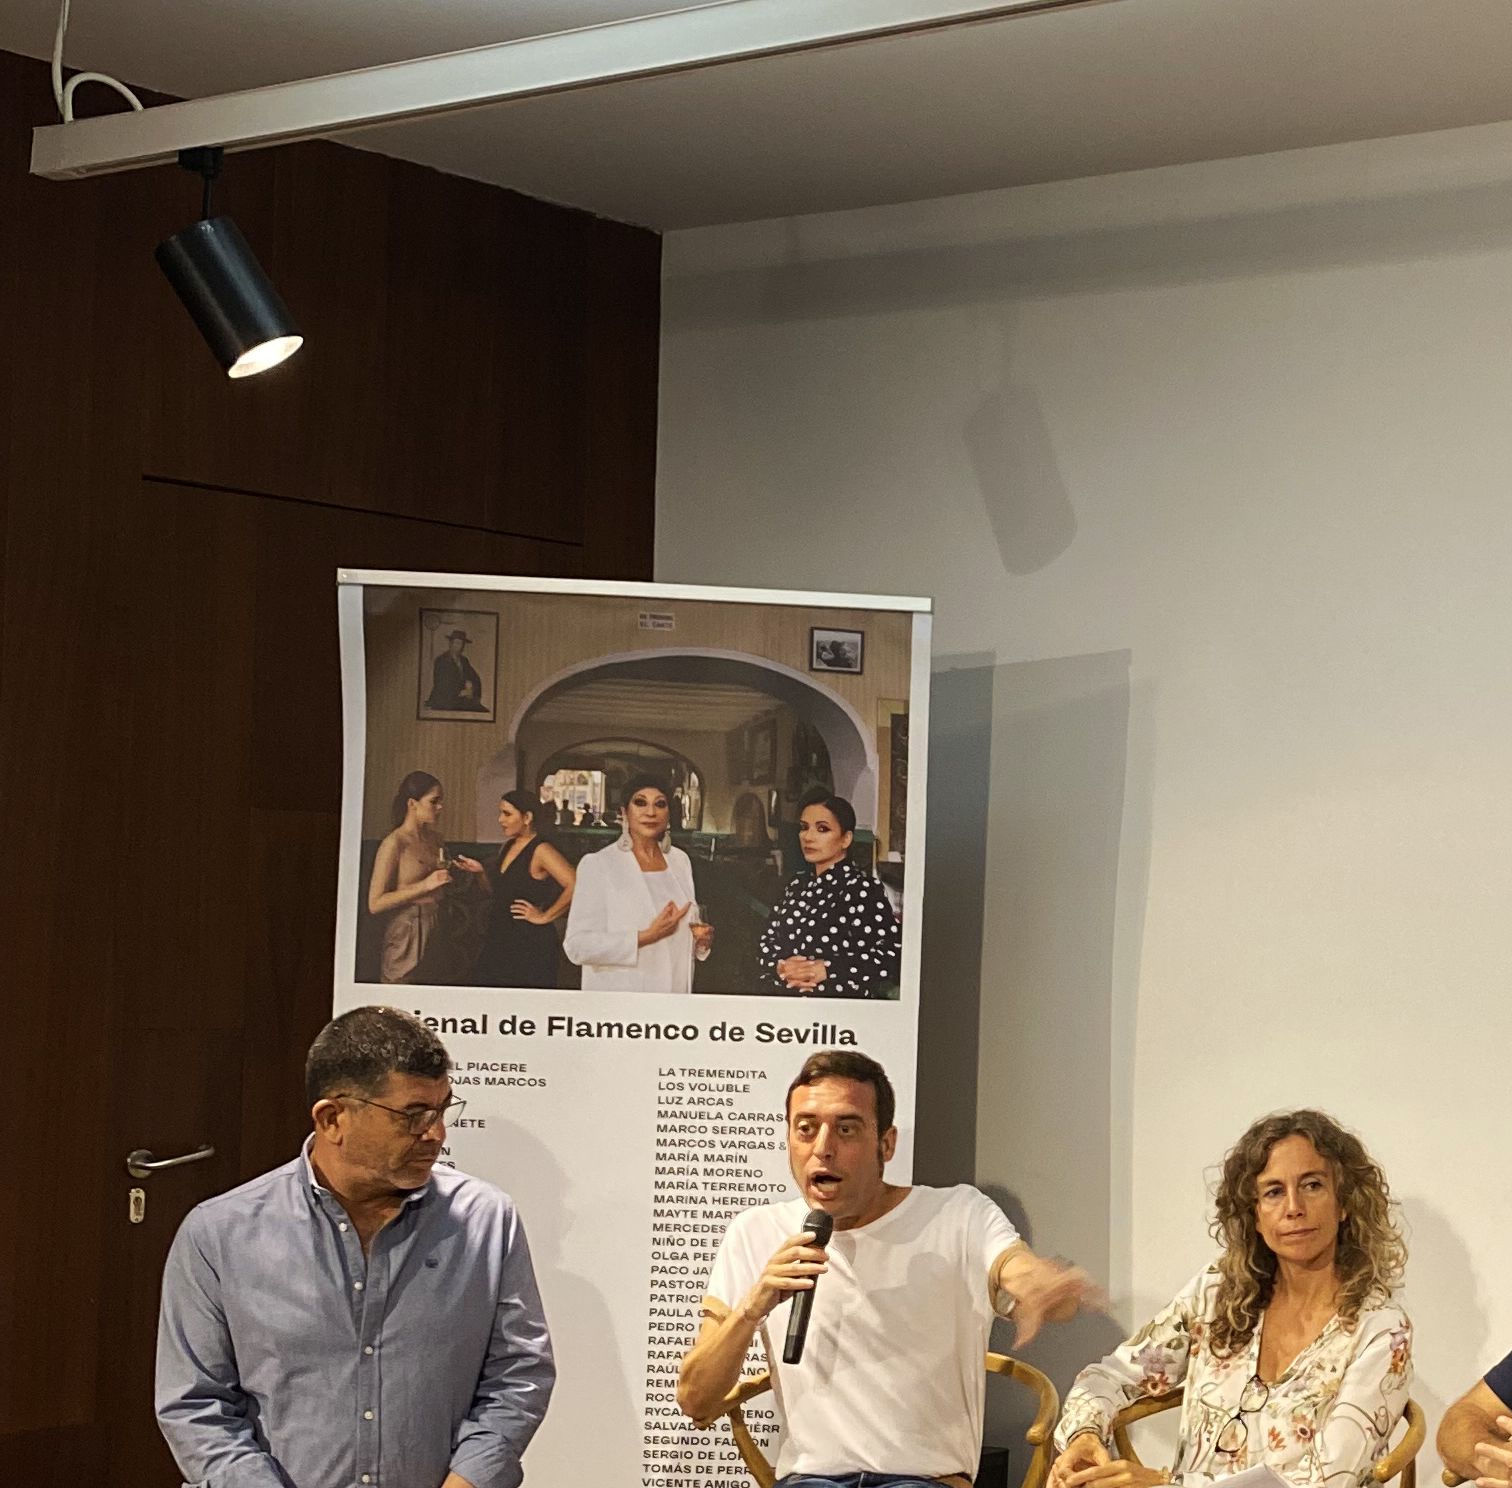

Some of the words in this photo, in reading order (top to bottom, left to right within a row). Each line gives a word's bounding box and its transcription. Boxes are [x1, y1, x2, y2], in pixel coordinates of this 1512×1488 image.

[414, 1010, 488, 1035] enal
[499, 1015, 536, 1036] de
[547, 1016, 699, 1042] Flamenco
[709, 1021, 745, 1043] de
[755, 1022, 858, 1046] Sevilla
[467, 1062, 527, 1072] PIACERE
[658, 1068, 676, 1077] LA
[680, 1068, 767, 1080] TREMENDITA
[449, 1076, 481, 1086] JAS
[484, 1077, 547, 1087] MARCOS
[658, 1081, 685, 1091] LOS
[688, 1082, 751, 1093] VOLUBLE
[657, 1096, 683, 1106] LUZ
[687, 1097, 734, 1107] ARCAS
[657, 1110, 724, 1121] MANUELA
[728, 1112, 787, 1122] CARRAS
[656, 1124, 708, 1134] MARCO
[712, 1126, 775, 1136] SERRATO
[656, 1138, 716, 1149] MARCOS
[720, 1140, 776, 1151] VARGAS
[778, 1141, 787, 1151] &
[655, 1151, 699, 1162] MARÍA
[703, 1152, 748, 1164] MARÍN
[654, 1165, 699, 1177] MARÍA
[703, 1168, 763, 1178] MORENO
[654, 1179, 699, 1191] MARÍA
[702, 1182, 787, 1193] TERREMOTO
[653, 1194, 707, 1205] MARINA
[712, 1196, 770, 1206] HEREDIA
[653, 1209, 698, 1219] MAYTE
[702, 1210, 740, 1220] MART
[652, 1223, 727, 1234] MERCEDES
[652, 1235, 686, 1247] NIÑO
[690, 1238, 708, 1247] DE
[651, 1251, 689, 1261] OLGA
[694, 1252, 717, 1262] PE
[650, 1265, 689, 1276] PACO
[693, 1266, 711, 1276] JA
[650, 1279, 708, 1290] PASTOR
[649, 1293, 703, 1304] PATRICI
[648, 1307, 693, 1317] PAULA
[648, 1321, 695, 1332] PEDRO
[646, 1362, 680, 1374] RAÚL
[646, 1379, 679, 1388] REM
[645, 1393, 676, 1403] ROC
[644, 1407, 682, 1417] RYCA
[643, 1421, 717, 1432] SALVADR
[643, 1435, 711, 1446] SEGUNDO
[714, 1436, 769, 1448] FALÓN
[642, 1450, 694, 1460] SERGIO
[698, 1451, 716, 1460] DE
[719, 1451, 744, 1461] LO
[642, 1462, 692, 1474] TOMÁS
[695, 1465, 713, 1474] DE
[717, 1465, 752, 1475] PERR
[641, 1478, 701, 1488] VICENTE
